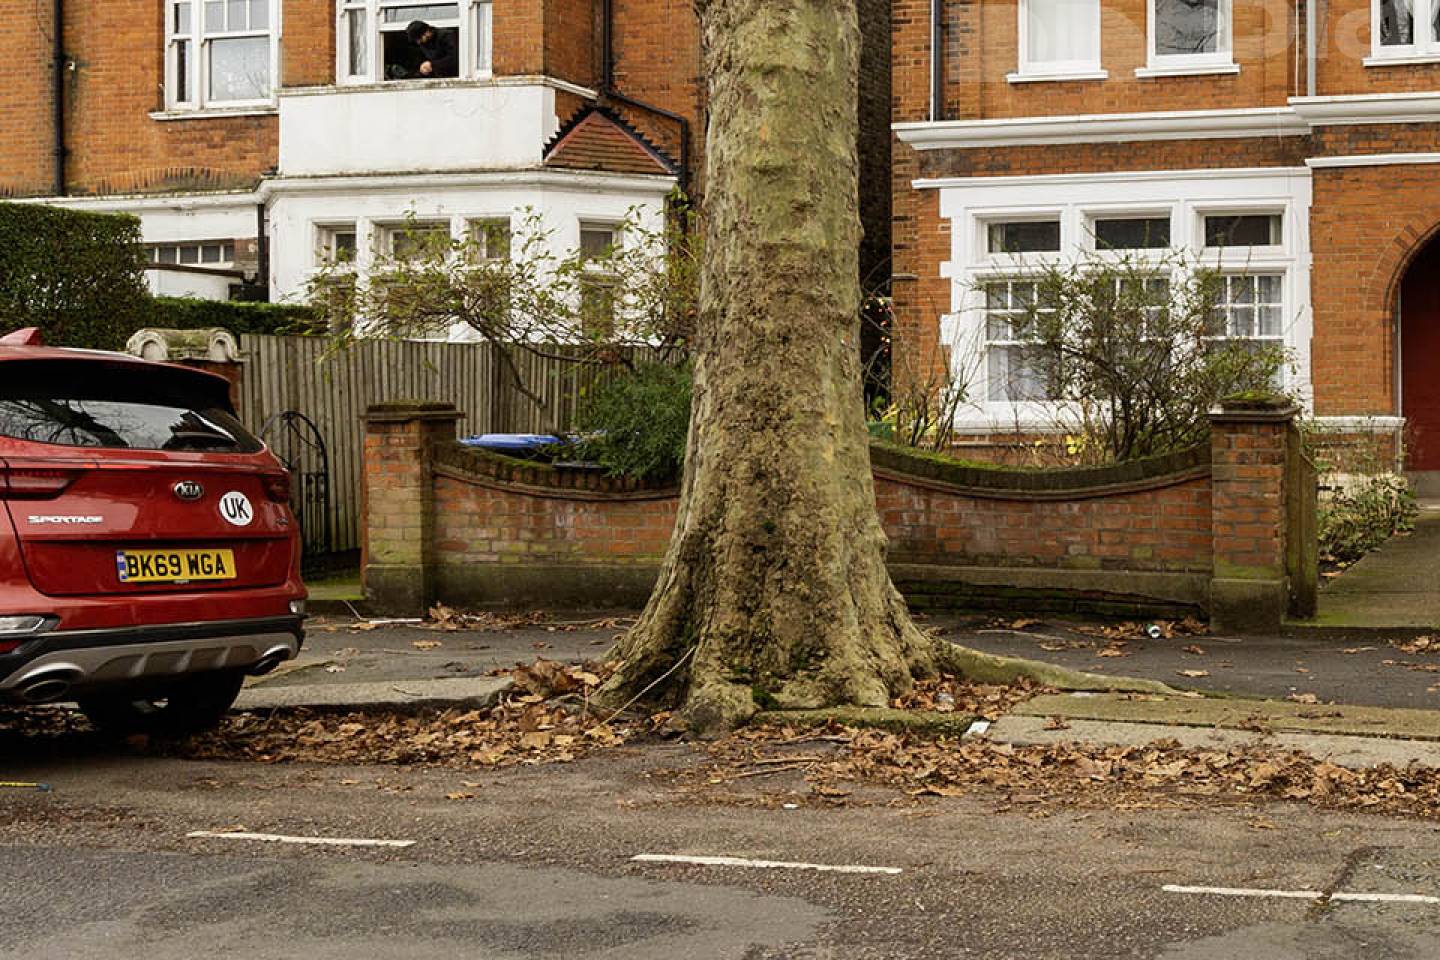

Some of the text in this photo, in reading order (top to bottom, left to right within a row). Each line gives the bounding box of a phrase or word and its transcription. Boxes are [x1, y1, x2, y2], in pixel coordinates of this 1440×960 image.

[223, 497, 250, 518] UK
[125, 553, 226, 577] BK69 WGA
